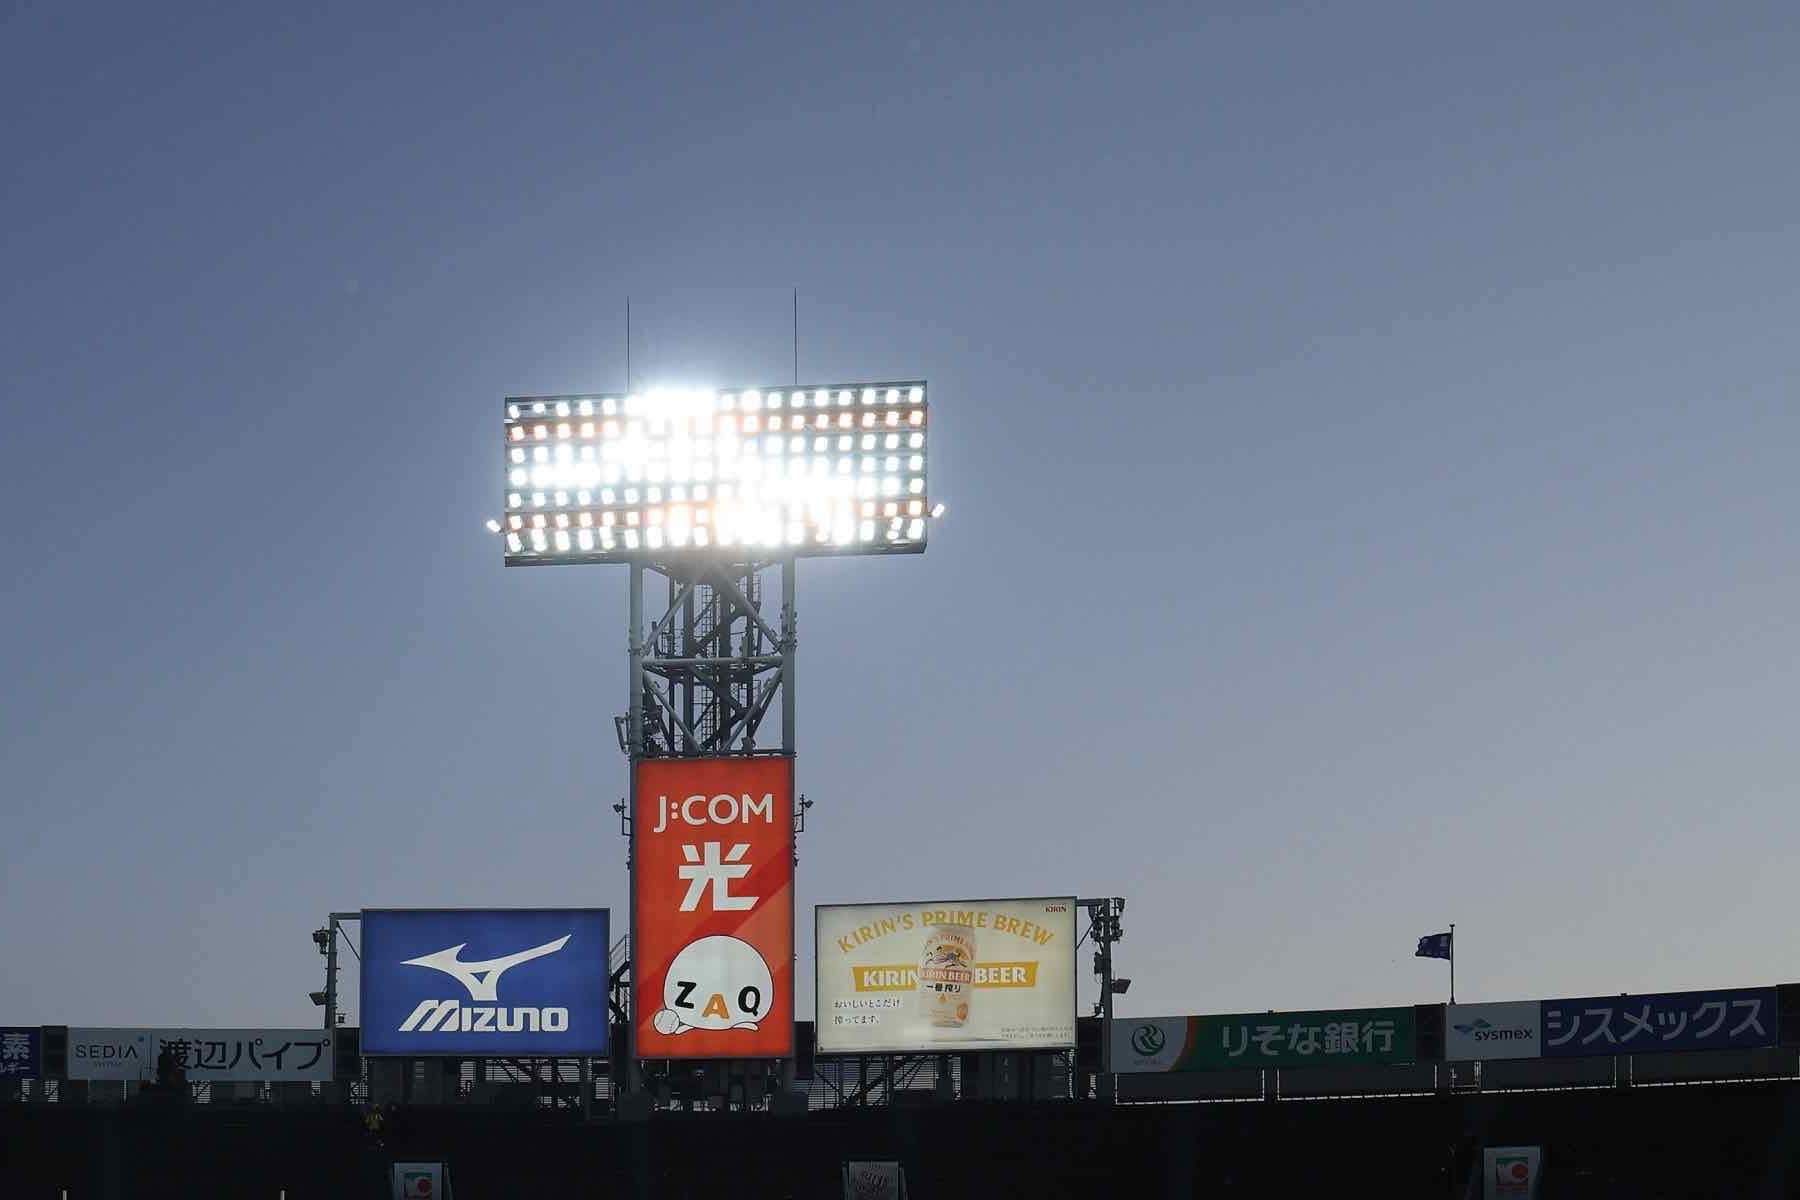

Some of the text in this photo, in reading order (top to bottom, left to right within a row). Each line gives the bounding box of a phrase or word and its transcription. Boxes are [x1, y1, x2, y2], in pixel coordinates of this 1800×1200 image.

[654, 793, 774, 833] J:COM
[678, 841, 760, 913] 光
[838, 910, 1055, 953] KIRIN'S PRIME BREW
[863, 966, 1028, 987] KIRIN BEER
[1222, 1019, 1396, 1057] りそな銀行
[1474, 1028, 1534, 1041] sysmex
[1547, 999, 1768, 1047] シスメックス
